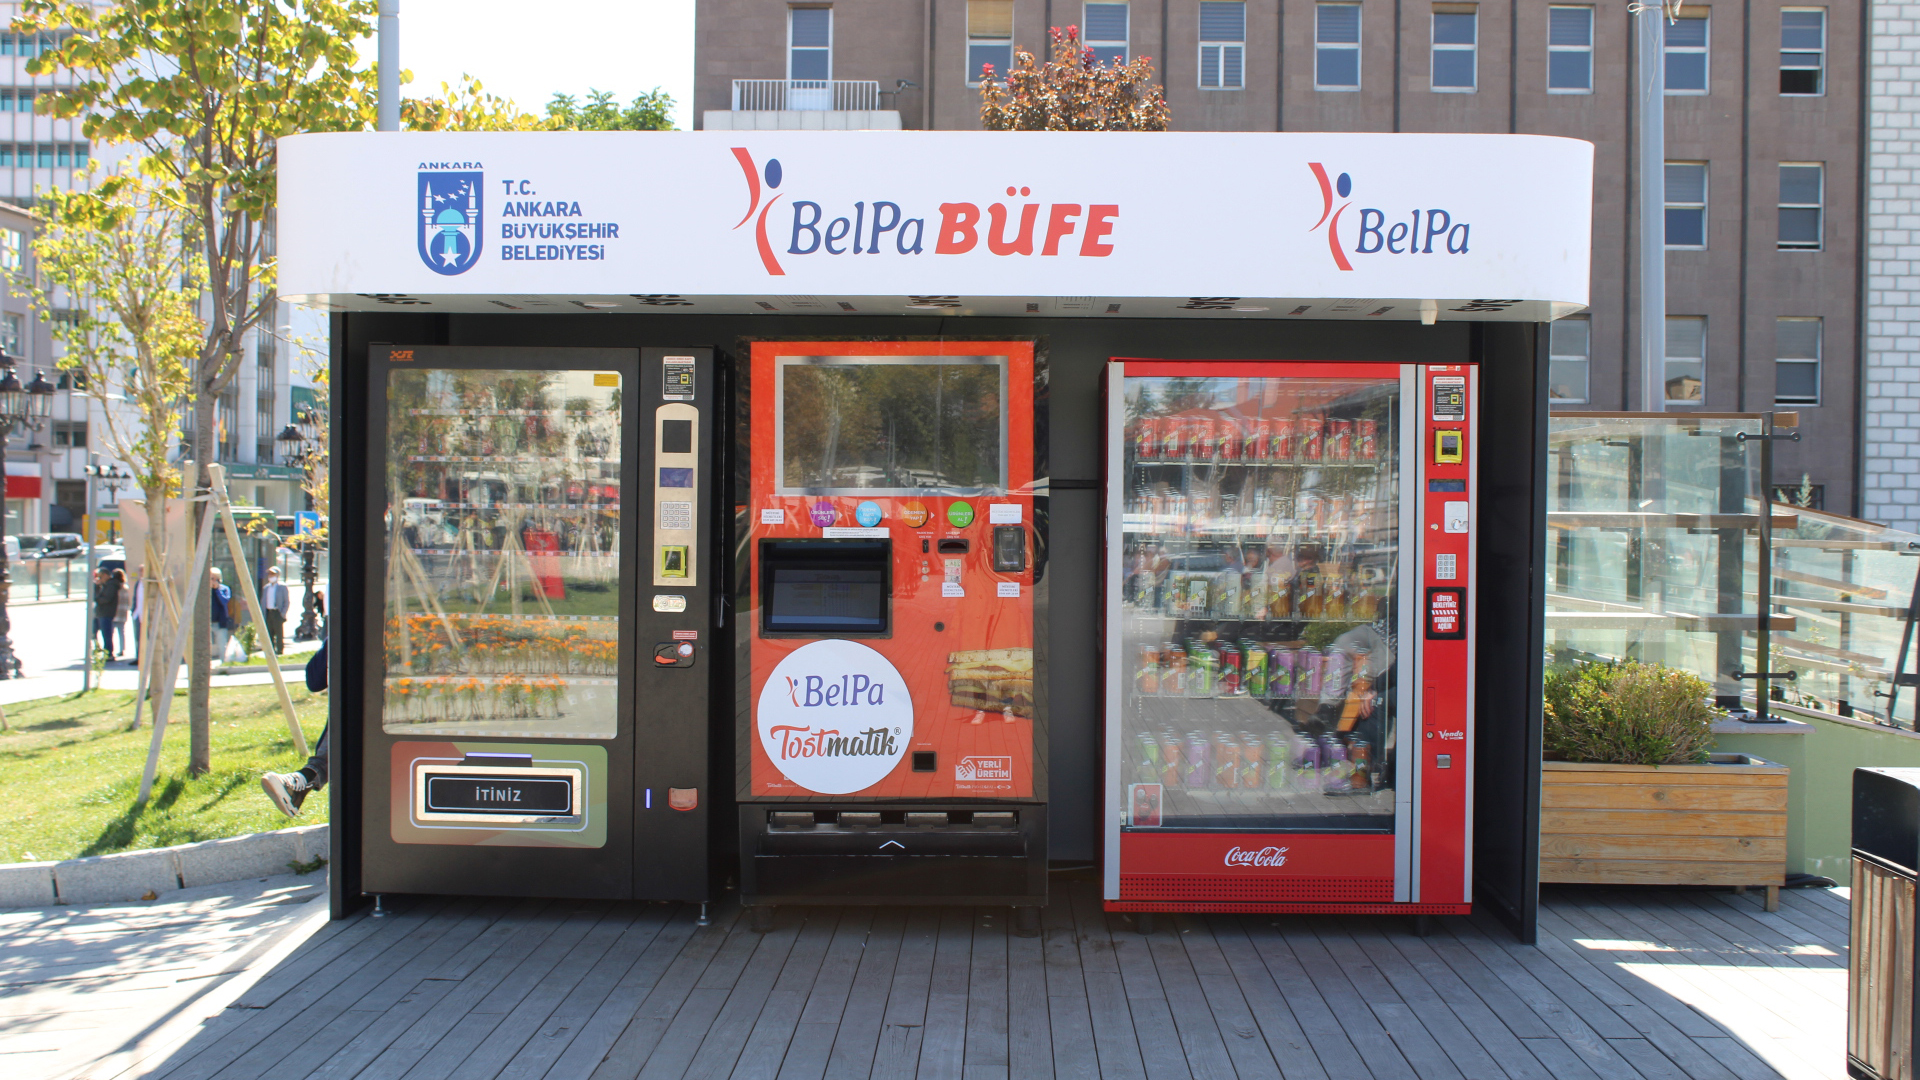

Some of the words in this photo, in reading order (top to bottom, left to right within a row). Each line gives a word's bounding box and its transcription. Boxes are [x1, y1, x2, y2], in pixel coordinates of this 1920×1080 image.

[417, 161, 484, 170] ANKARA
[502, 179, 537, 196] T.C.
[502, 201, 583, 218] ANKARA
[786, 200, 925, 256] BelPa
[934, 186, 1120, 257] BÜFE
[501, 222, 620, 241] BÜYÜKŞEHİR
[1354, 207, 1471, 255] BelPa
[501, 244, 606, 261] BELEDİYESİ
[803, 674, 884, 707] BelPa
[1438, 729, 1464, 739] Vendo
[977, 759, 1002, 769] YERLİ
[977, 769, 1009, 778] ÜRETİM
[475, 786, 521, 802] İTİNİZ
[1224, 846, 1290, 867] Coca-Cola
